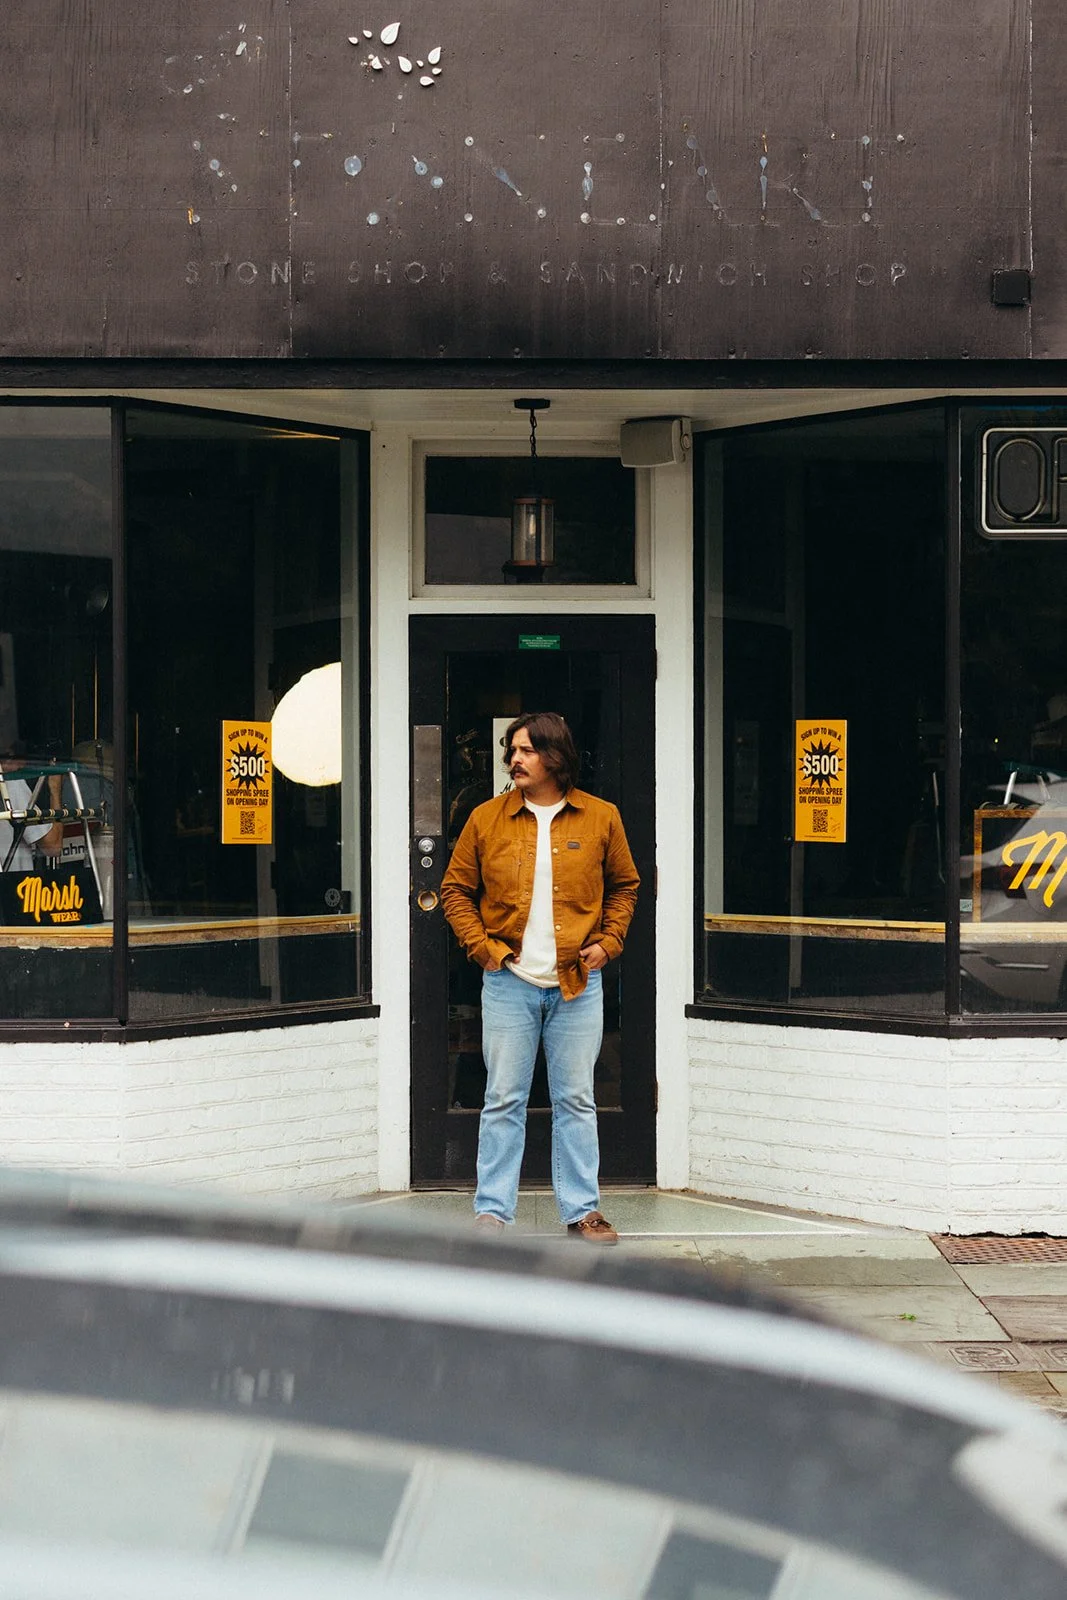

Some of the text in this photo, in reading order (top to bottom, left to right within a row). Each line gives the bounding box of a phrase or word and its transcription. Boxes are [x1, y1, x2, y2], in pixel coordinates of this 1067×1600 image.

[184, 260, 316, 285] STONE
[540, 260, 767, 287] SANDWICH
[800, 262, 907, 287] SHOP
[992, 437, 1067, 524] O
[228, 730, 240, 742] SIGN
[240, 728, 247, 736] UP
[248, 728, 254, 736] TO
[255, 730, 264, 740] WIN
[800, 728, 812, 741] SIGN
[813, 727, 820, 735] UP
[821, 727, 827, 735] TO
[828, 728, 837, 738] WIN
[230, 754, 266, 779] $500
[803, 752, 839, 778] $500
[226, 788, 269, 797] SHOPPING SPREE
[798, 787, 843, 796] SHOPPING SPREE
[226, 797, 268, 806] ON OPENING DAY
[799, 796, 807, 804] ON
[807, 796, 831, 804] OPENING
[62, 842, 86, 857] ohn
[16, 875, 84, 923] Marsh
[50, 911, 81, 923] WEAR
